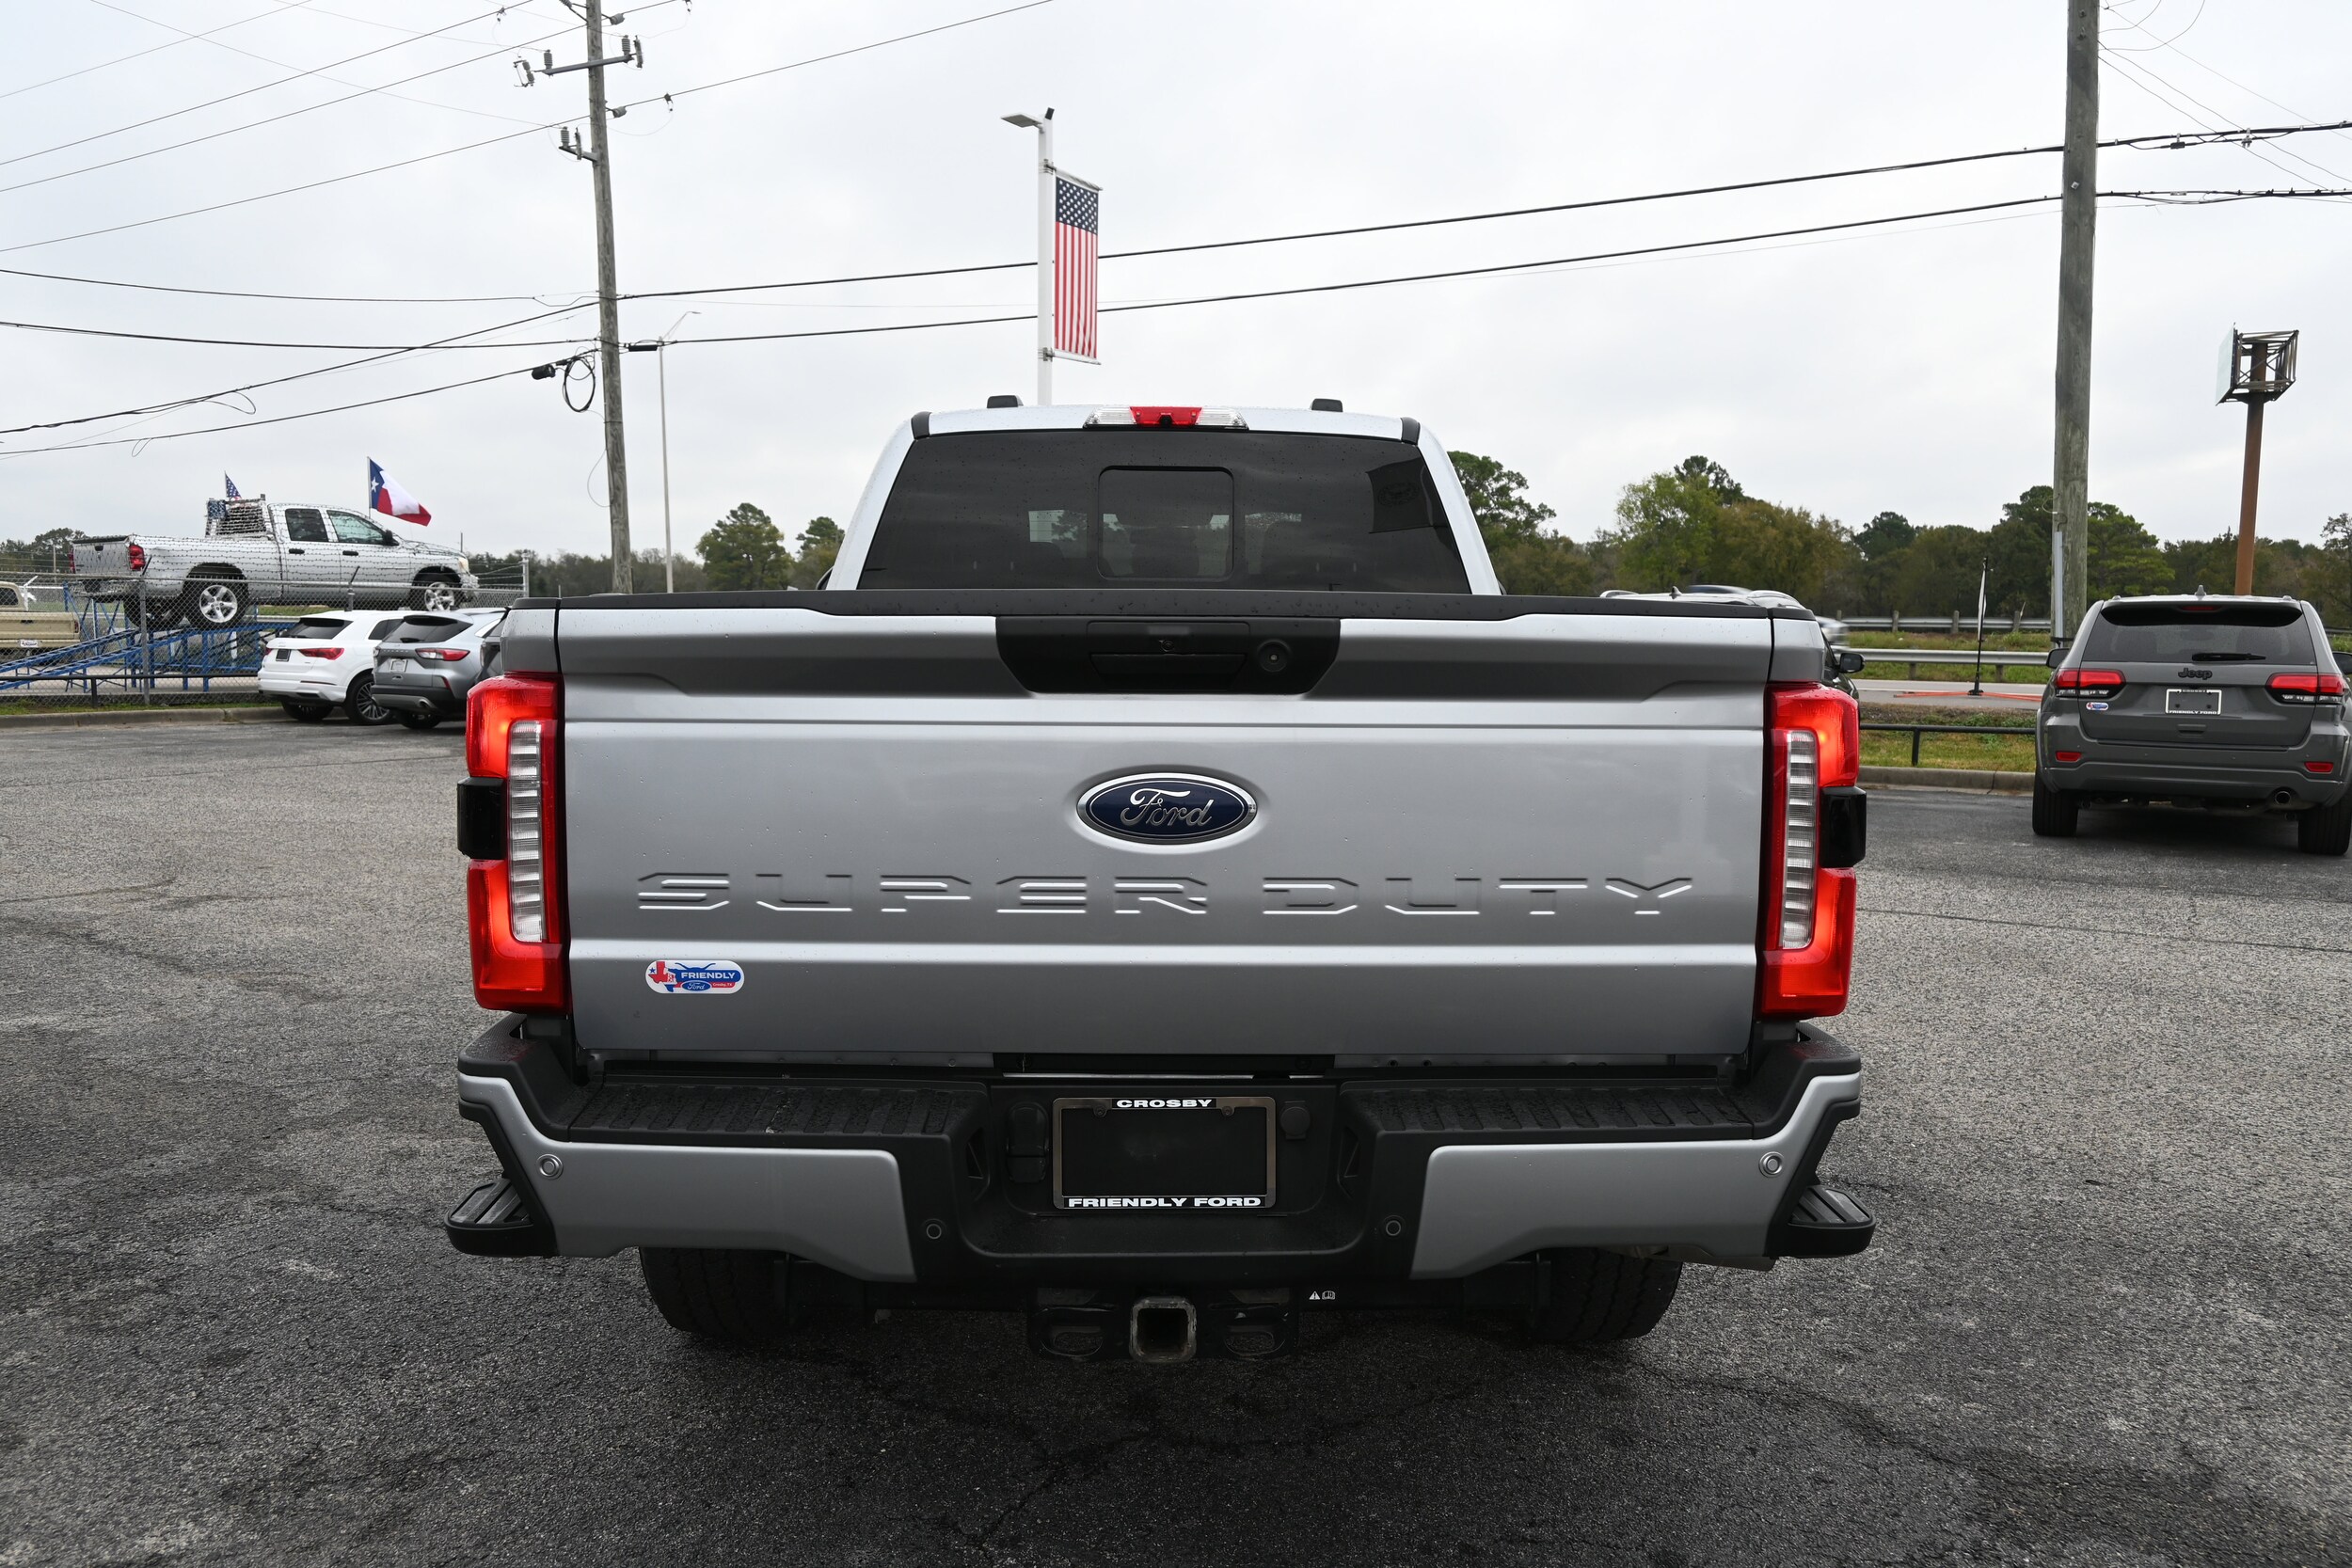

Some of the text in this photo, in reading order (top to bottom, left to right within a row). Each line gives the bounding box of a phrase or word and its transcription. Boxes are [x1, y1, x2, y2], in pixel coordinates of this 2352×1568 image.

[2178, 667, 2213, 680] Jeep
[1120, 787, 1215, 827] Ford
[638, 872, 1693, 916] SUPER DUTY
[687, 982, 706, 990] Ford
[1116, 1099, 1213, 1109] CROSBY
[1068, 1197, 1262, 1208] FRIENDLY FORD
